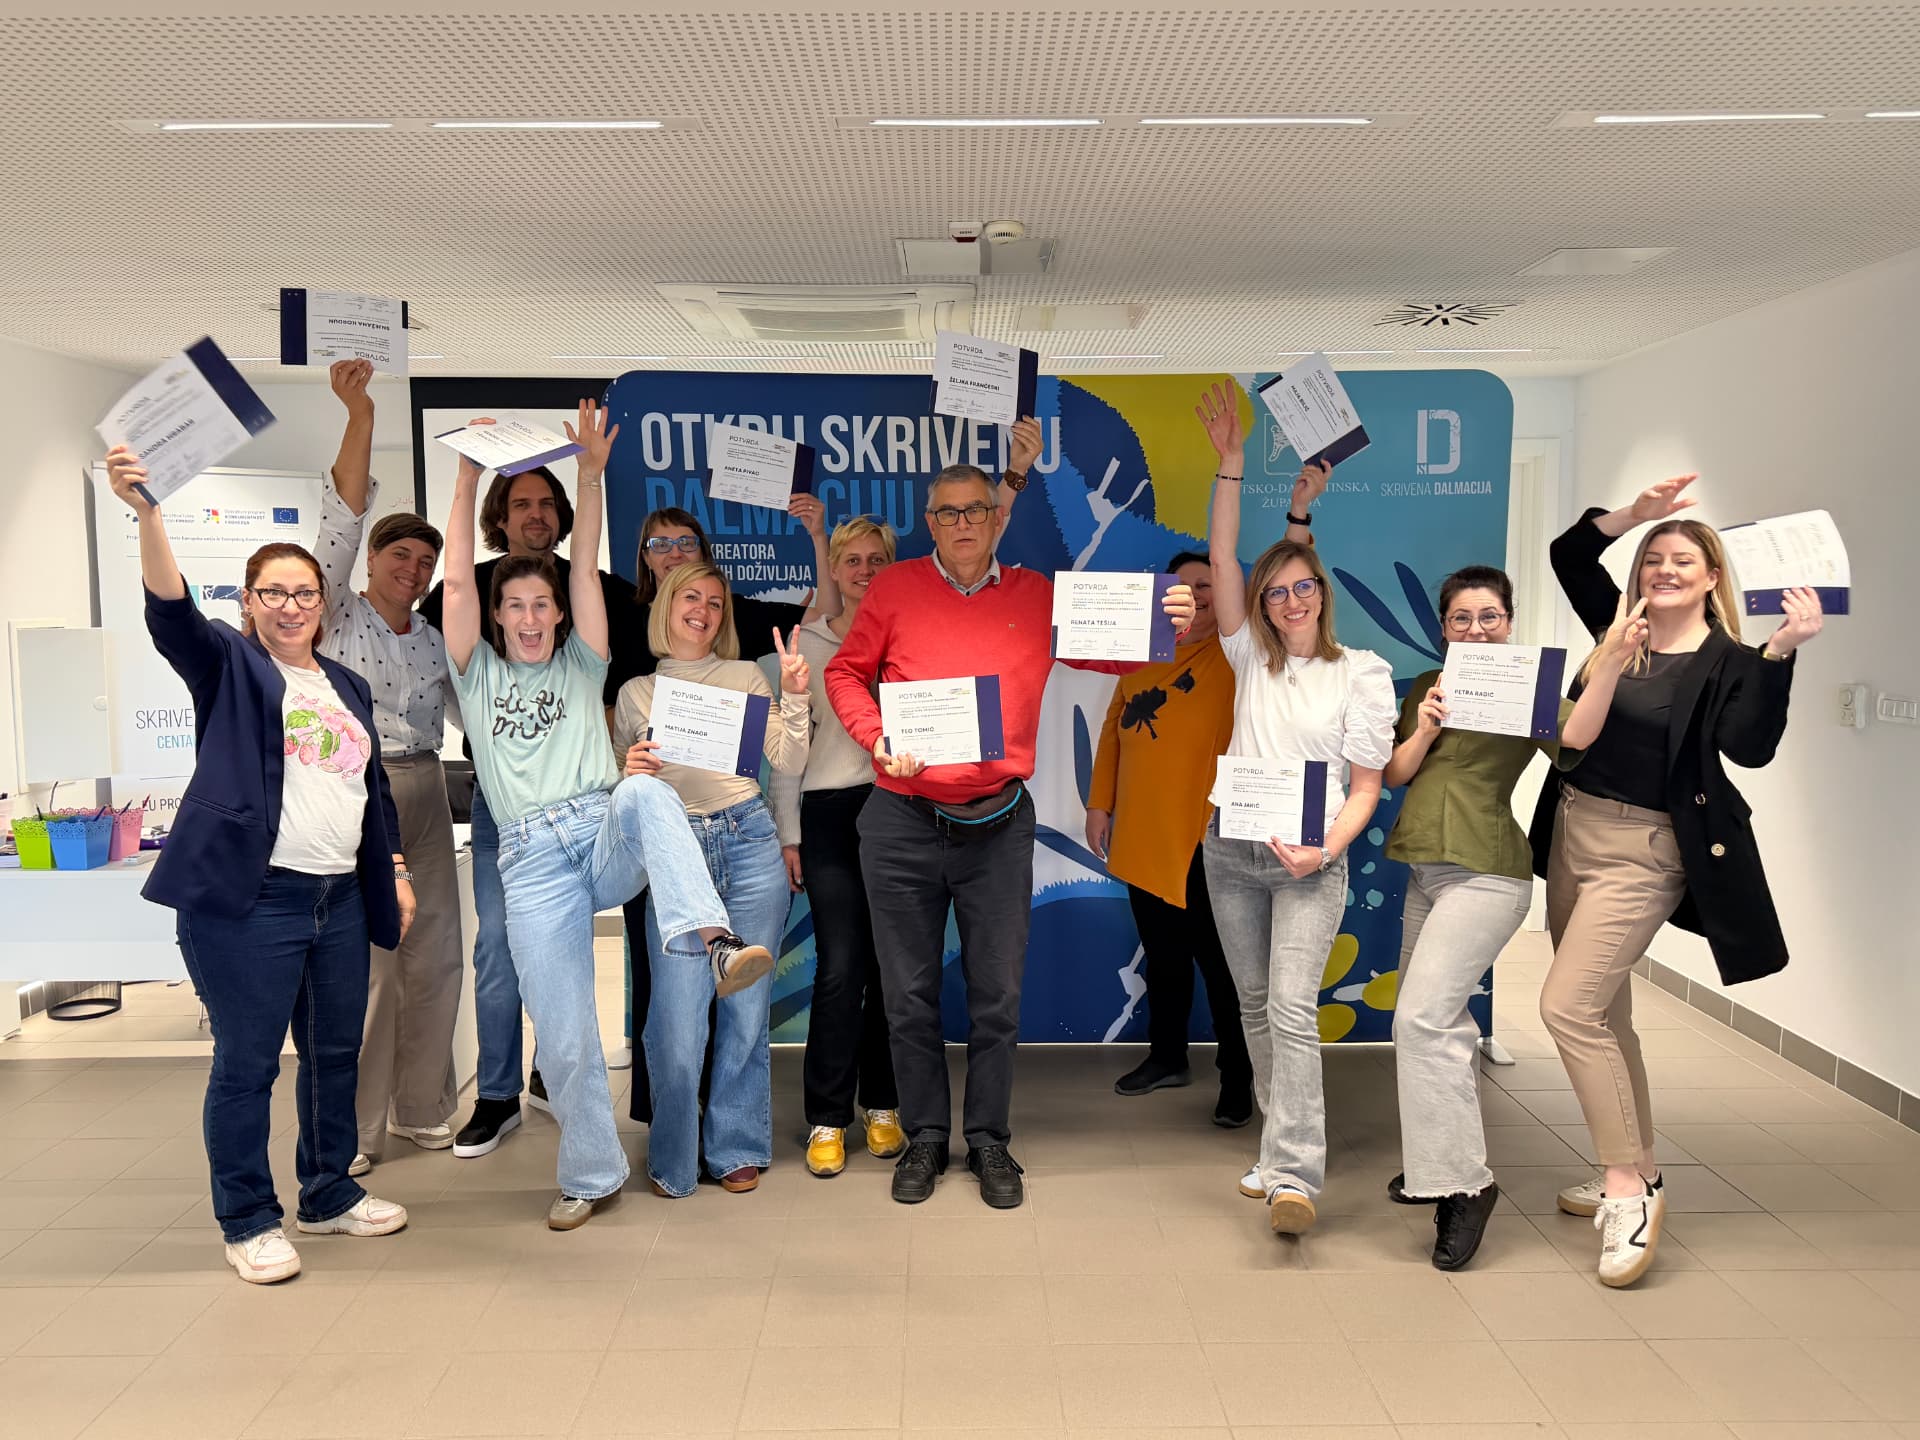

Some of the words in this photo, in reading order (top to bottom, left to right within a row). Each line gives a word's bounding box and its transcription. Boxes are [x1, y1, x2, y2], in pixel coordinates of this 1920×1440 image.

[953, 343, 984, 354] POTVRDA
[354, 351, 390, 362] POTVRDA
[1316, 369, 1335, 398] POTVRDA
[729, 435, 760, 446] POTVRDA
[724, 465, 742, 473] ANETA
[1381, 482, 1432, 497] SKRIVENA
[1434, 480, 1492, 495] DALMACIJA
[737, 561, 812, 581] DOŽIVLJAJA
[1462, 653, 1495, 662] POTVRDA
[671, 690, 704, 702] POTVRDA
[898, 691, 933, 700] POTVRDA
[1454, 689, 1474, 697] PETRA
[1474, 690, 1495, 698] RADIĆ
[136, 708, 193, 730] SKRIVE
[664, 724, 686, 734] MATIJA
[687, 728, 708, 737] ZNAOR
[157, 735, 193, 749] CENTA
[1233, 767, 1264, 775] POTVRDA
[159, 797, 181, 811] PRO
